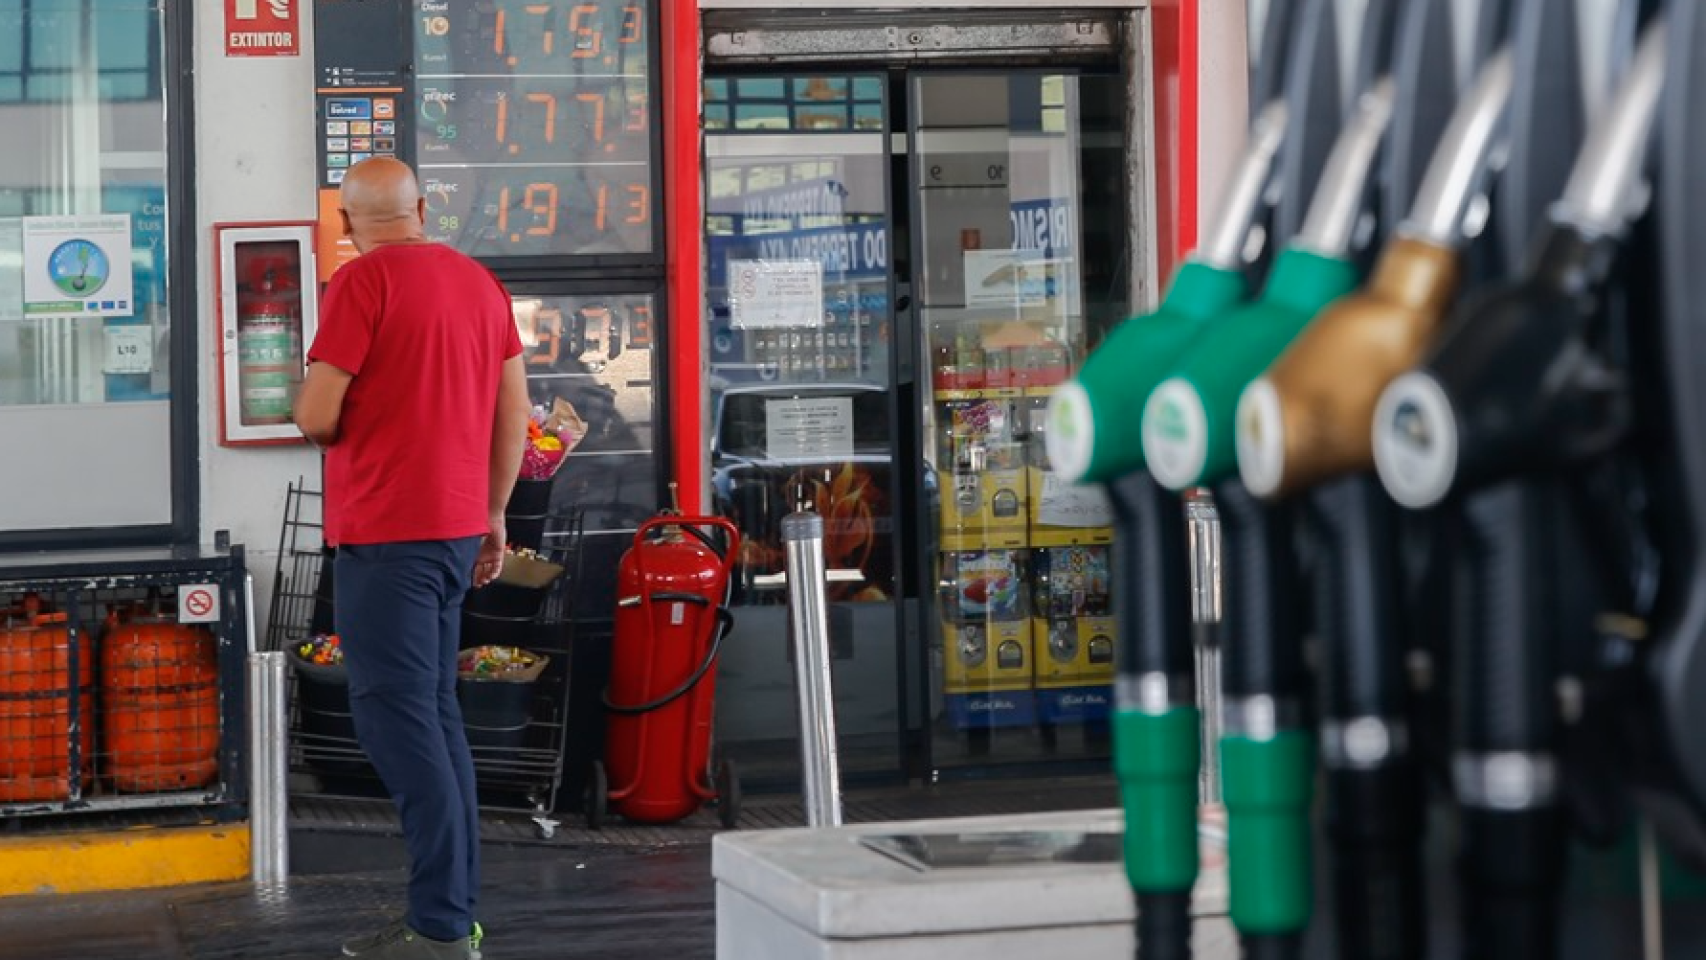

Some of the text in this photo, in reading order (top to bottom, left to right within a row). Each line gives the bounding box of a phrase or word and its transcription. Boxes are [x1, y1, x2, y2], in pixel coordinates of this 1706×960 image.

[230, 32, 292, 47] EXTINTOR
[436, 125, 457, 139] 95
[138, 220, 161, 232] tus
[439, 216, 459, 230] 98
